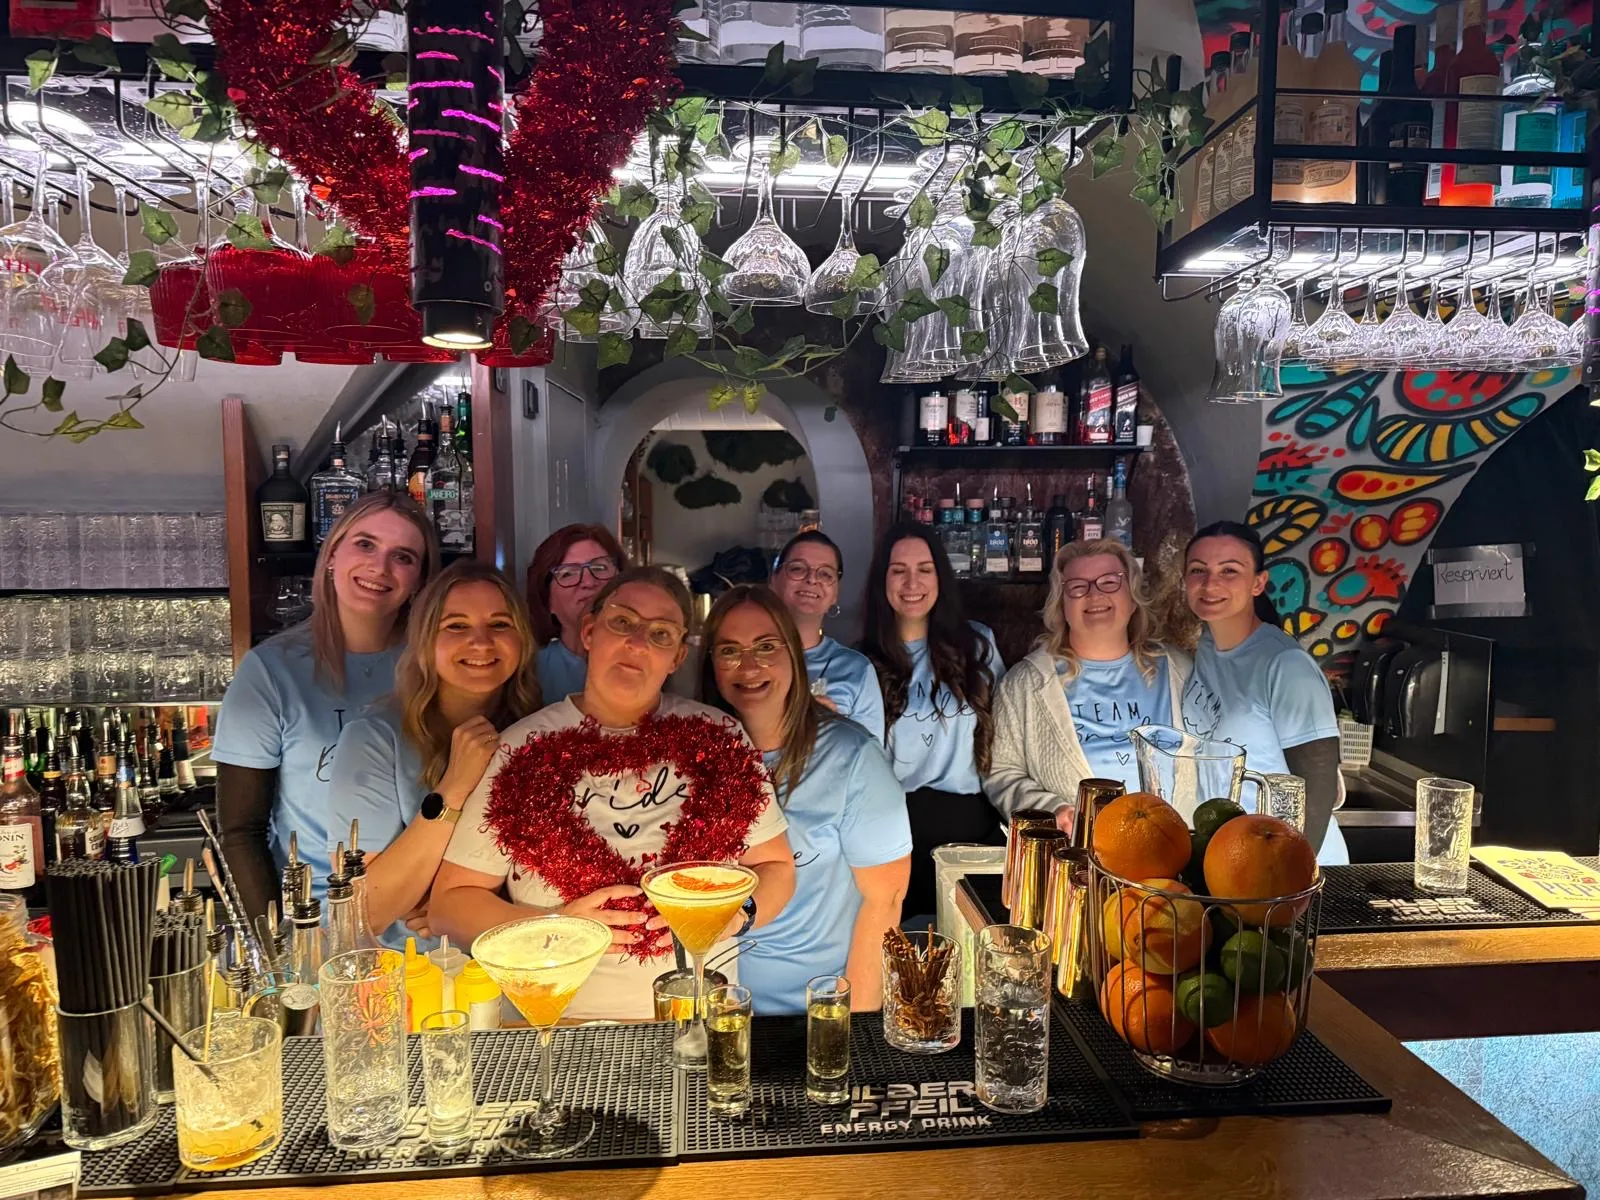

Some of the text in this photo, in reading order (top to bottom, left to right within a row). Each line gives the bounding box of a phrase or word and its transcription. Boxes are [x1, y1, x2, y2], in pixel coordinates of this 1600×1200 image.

[1436, 560, 1514, 585] Reserviert
[1074, 702, 1141, 722] TEAM
[568, 766, 690, 811] ride
[851, 1080, 976, 1102] ILBER
[850, 1097, 975, 1122] PFEIL
[820, 1114, 993, 1136] ENERGY DRINK
